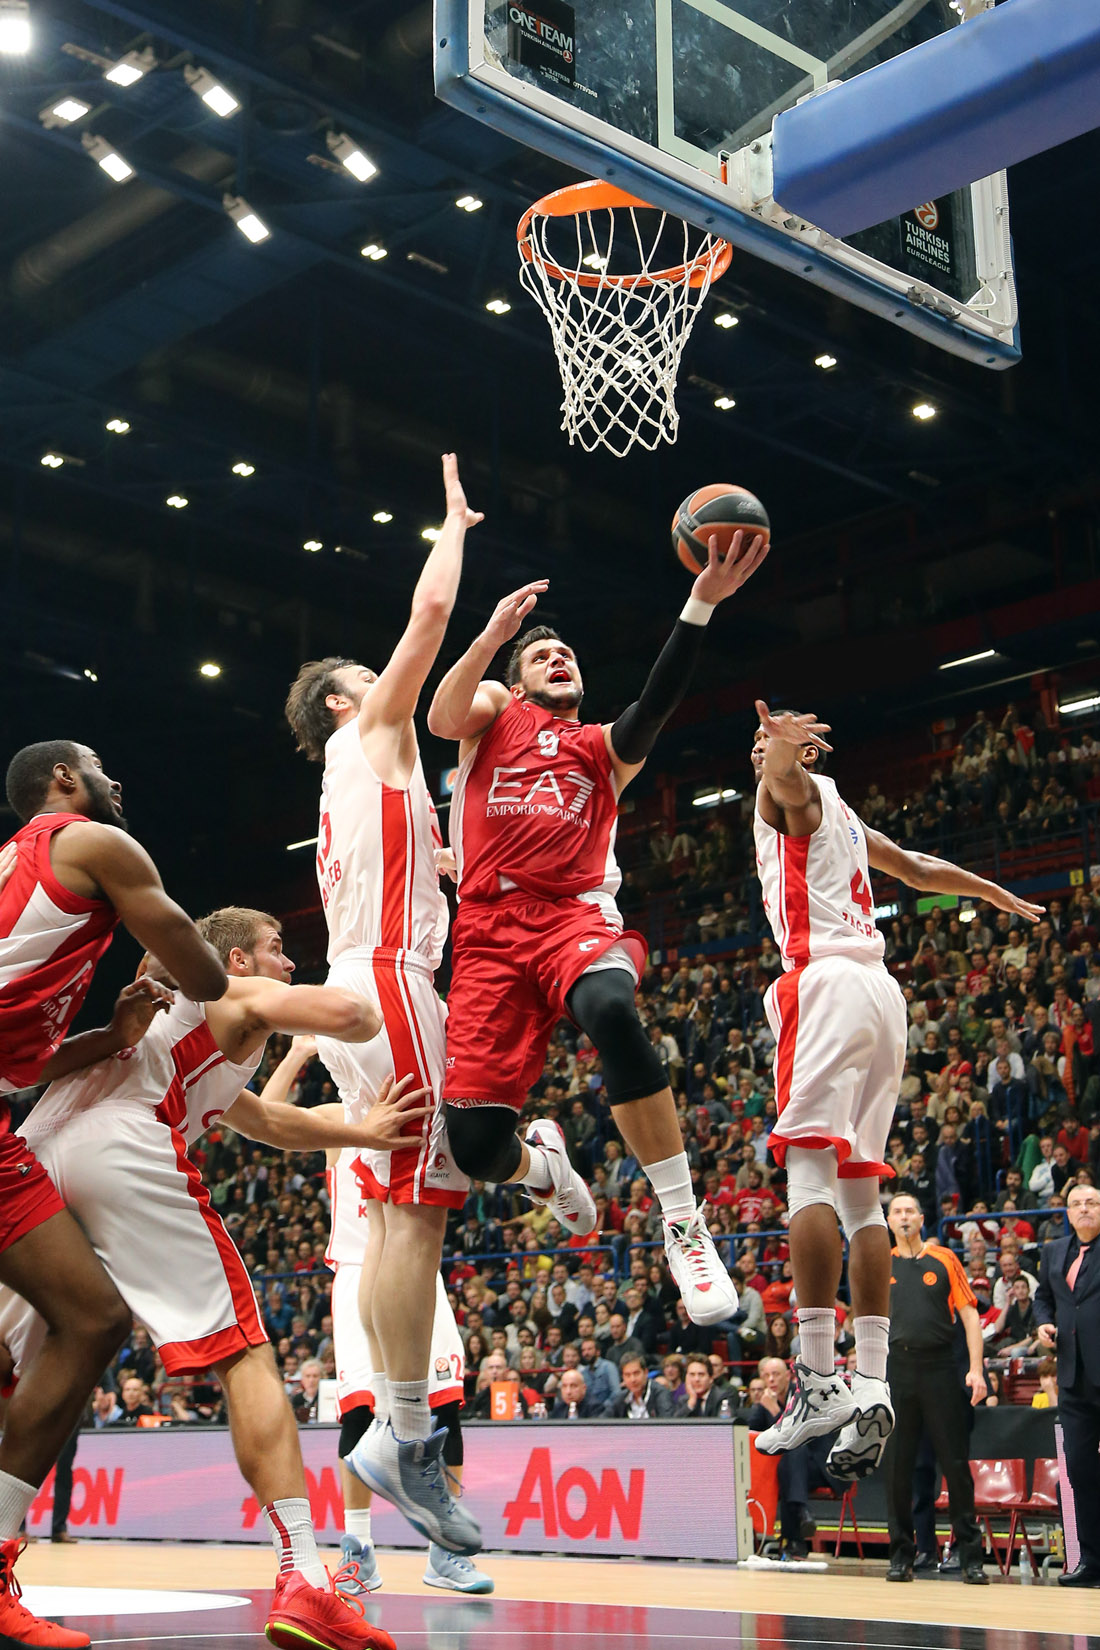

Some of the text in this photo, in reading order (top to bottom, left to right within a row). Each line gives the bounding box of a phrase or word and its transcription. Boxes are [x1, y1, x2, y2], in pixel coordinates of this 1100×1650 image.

[520, 30, 563, 56] TURKISH AIRLINES
[905, 220, 949, 253] TURKISH
[906, 234, 950, 263] AIRLINES
[906, 246, 951, 273] EUROLEAGUE
[537, 730, 560, 757] 9
[486, 803, 542, 818] EMPORIO
[850, 868, 872, 916] 4
[495, 1391, 507, 1415] 5
[502, 1447, 645, 1541] AON
